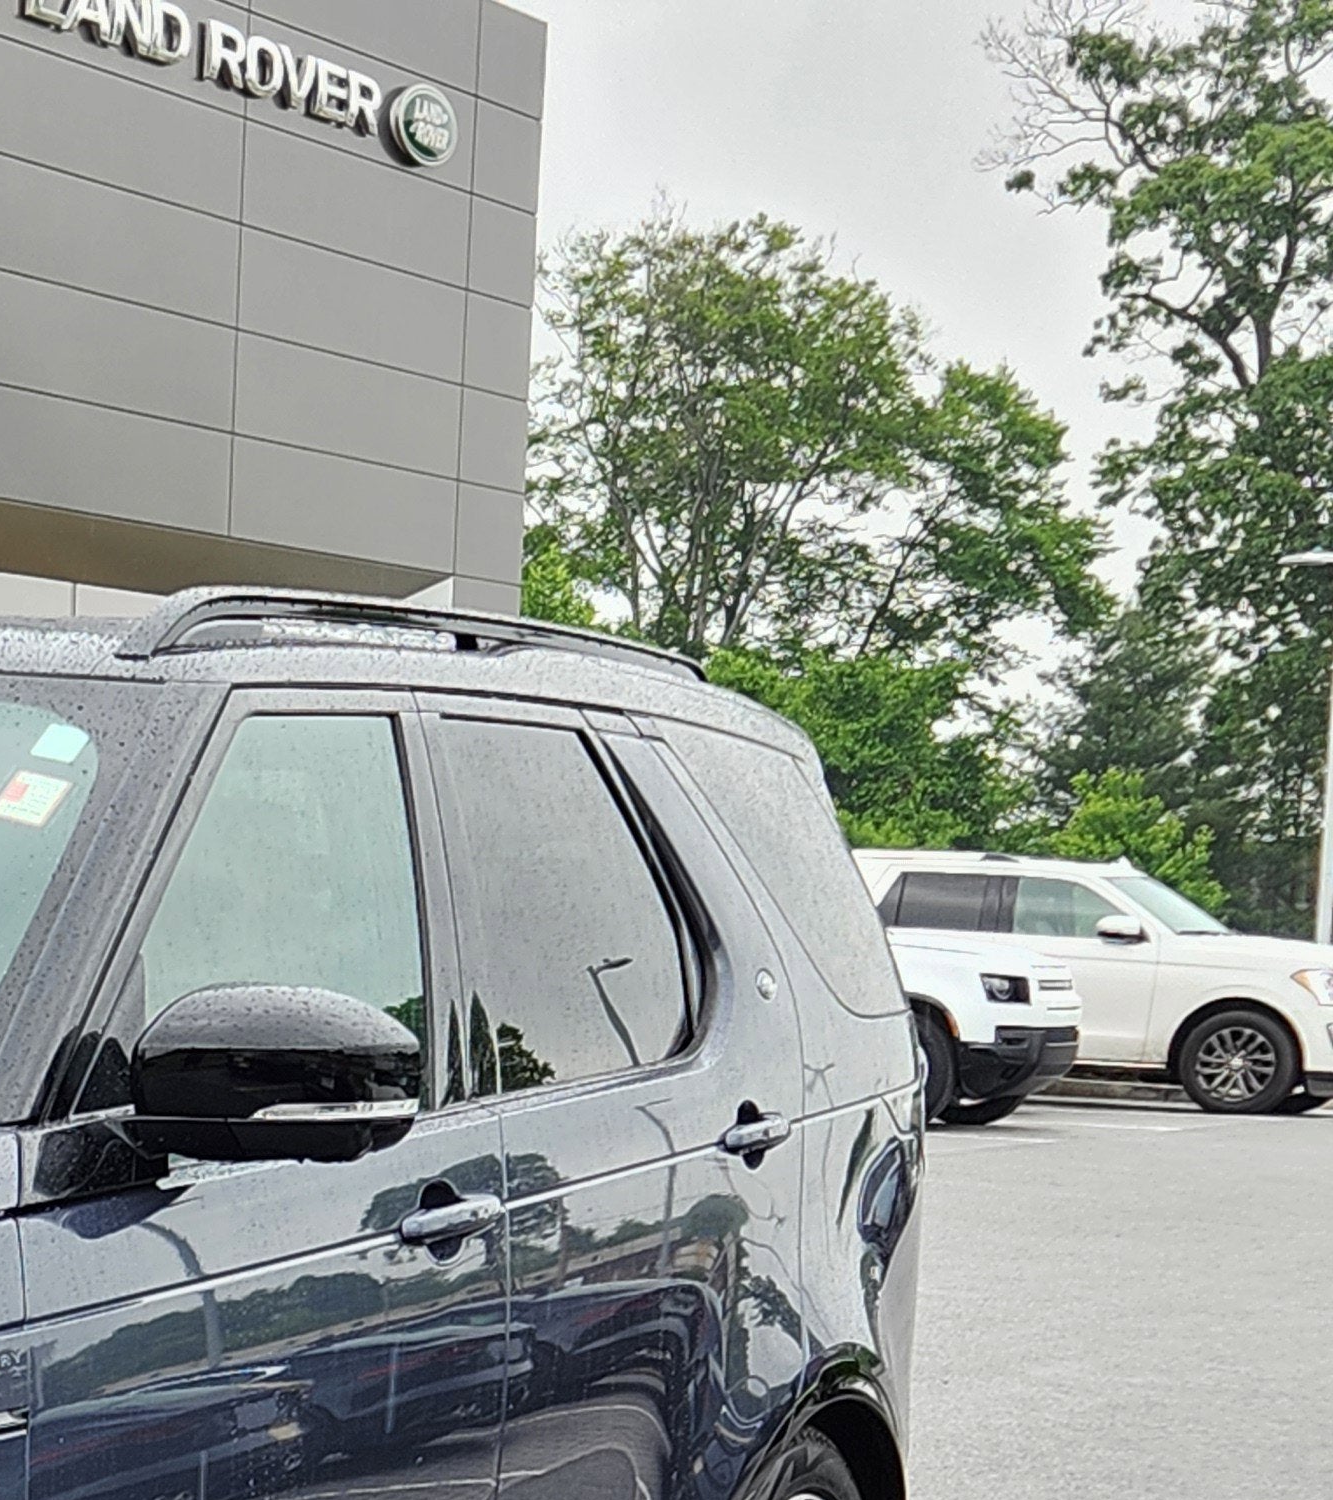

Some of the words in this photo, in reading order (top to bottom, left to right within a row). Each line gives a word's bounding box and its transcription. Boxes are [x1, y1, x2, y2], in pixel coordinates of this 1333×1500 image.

[201, 18, 382, 137] ROVER
[414, 97, 448, 125] LAND
[409, 121, 450, 150] ROVER
